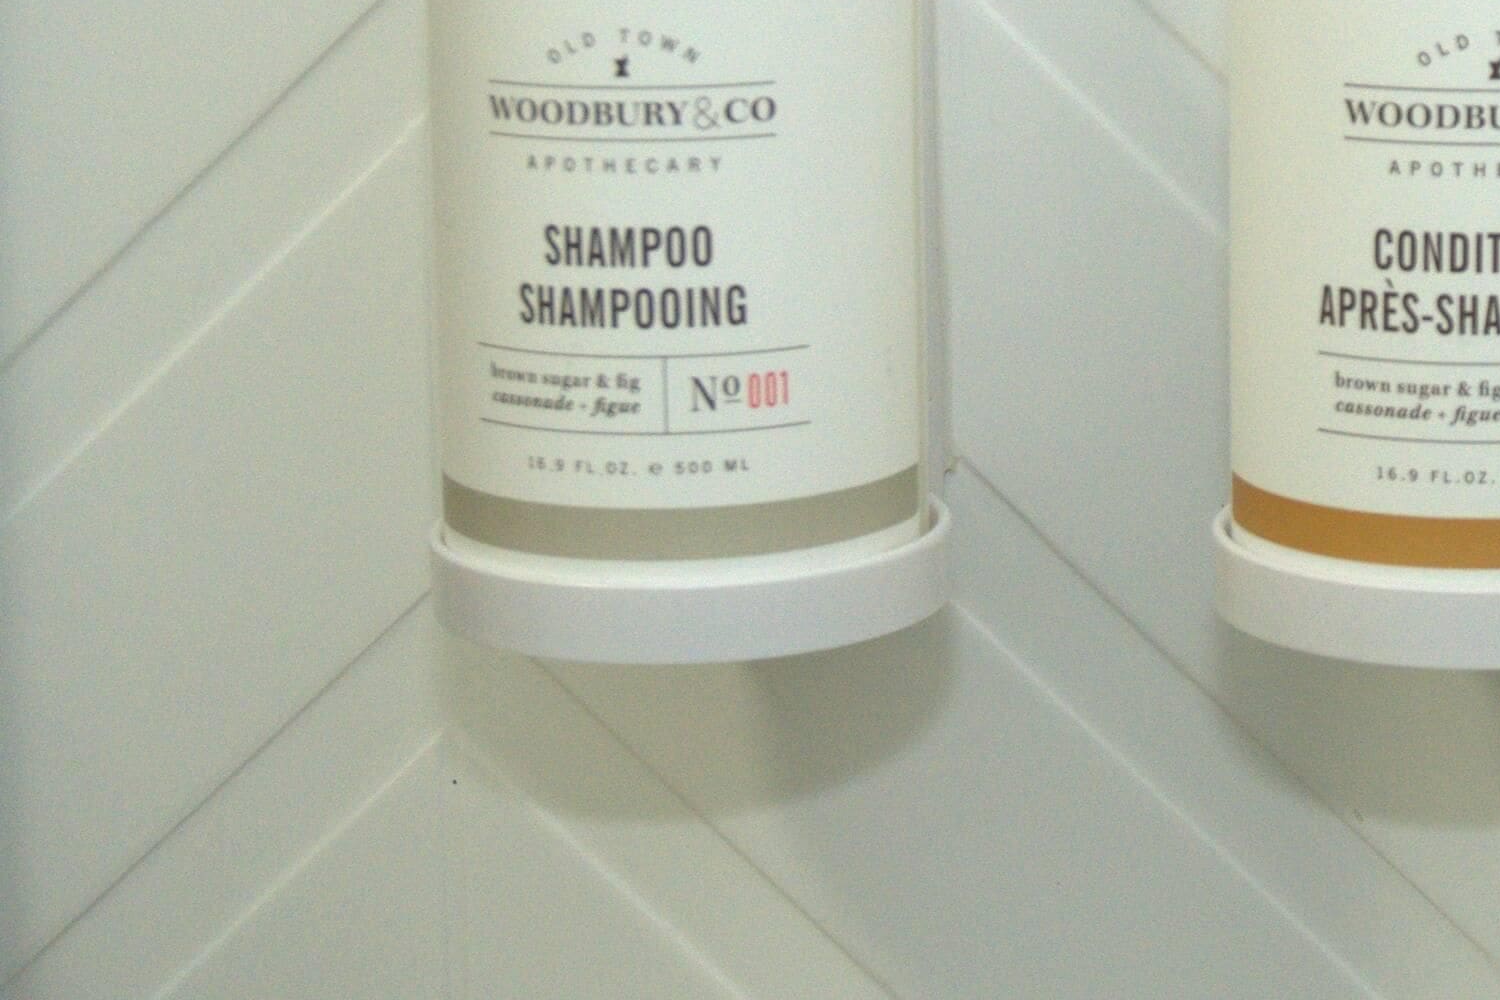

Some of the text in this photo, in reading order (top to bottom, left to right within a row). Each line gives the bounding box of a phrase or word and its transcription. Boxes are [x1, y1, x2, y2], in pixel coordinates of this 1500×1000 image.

[547, 28, 700, 65] OLD TOWN
[1417, 33, 1470, 67] OLD
[527, 155, 721, 174] APOTHECARY
[544, 224, 712, 268] SHAMPOO
[519, 283, 747, 329] SHAMPOOING
[490, 361, 641, 393] brown sugar & fig
[1334, 371, 1390, 392] brown
[1397, 380, 1450, 401] sugar
[1457, 382, 1472, 396] &
[491, 390, 574, 412] cassonade
[591, 397, 641, 417] figue
[1335, 399, 1432, 420] cassonade
[528, 455, 564, 472] 16.9
[675, 461, 713, 474] 500
[724, 458, 749, 472] ML
[1377, 467, 1418, 482] 16.9
